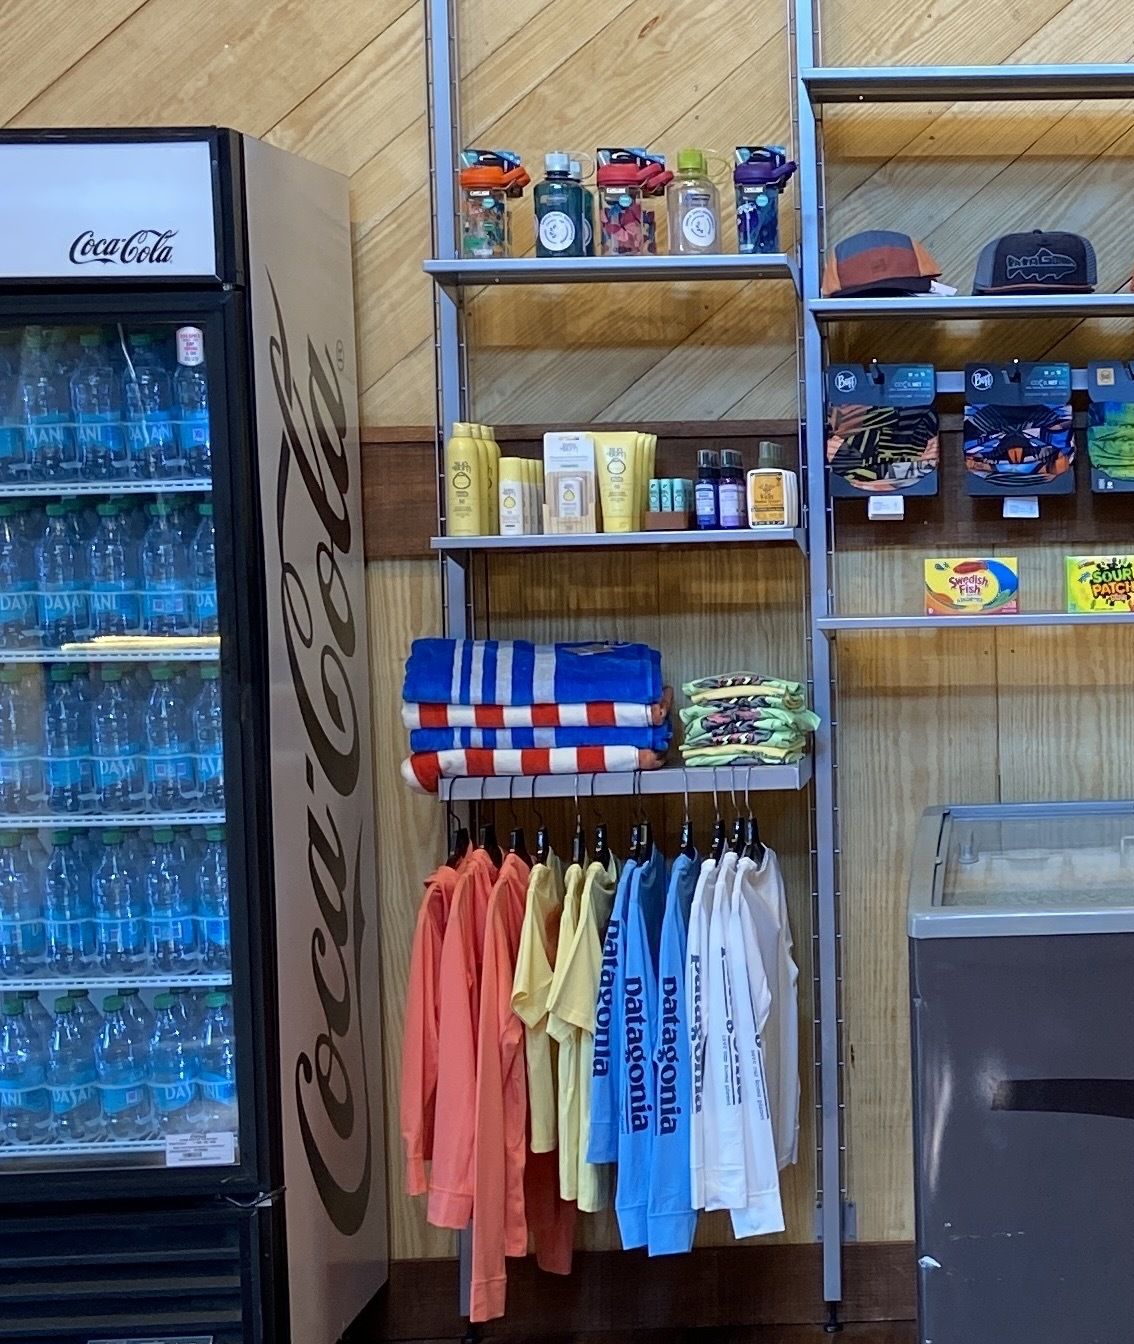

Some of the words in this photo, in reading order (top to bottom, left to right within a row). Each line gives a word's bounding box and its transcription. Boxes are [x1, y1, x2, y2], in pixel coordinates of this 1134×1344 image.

[69, 229, 179, 264] Coca-Cola
[948, 574, 989, 590] Swedish
[959, 584, 981, 594] Fish
[1091, 567, 1133, 584] SOUR
[264, 264, 367, 1236] Coca-Cola
[624, 976, 653, 1134] patagonia
[657, 975, 682, 1136] patagonia
